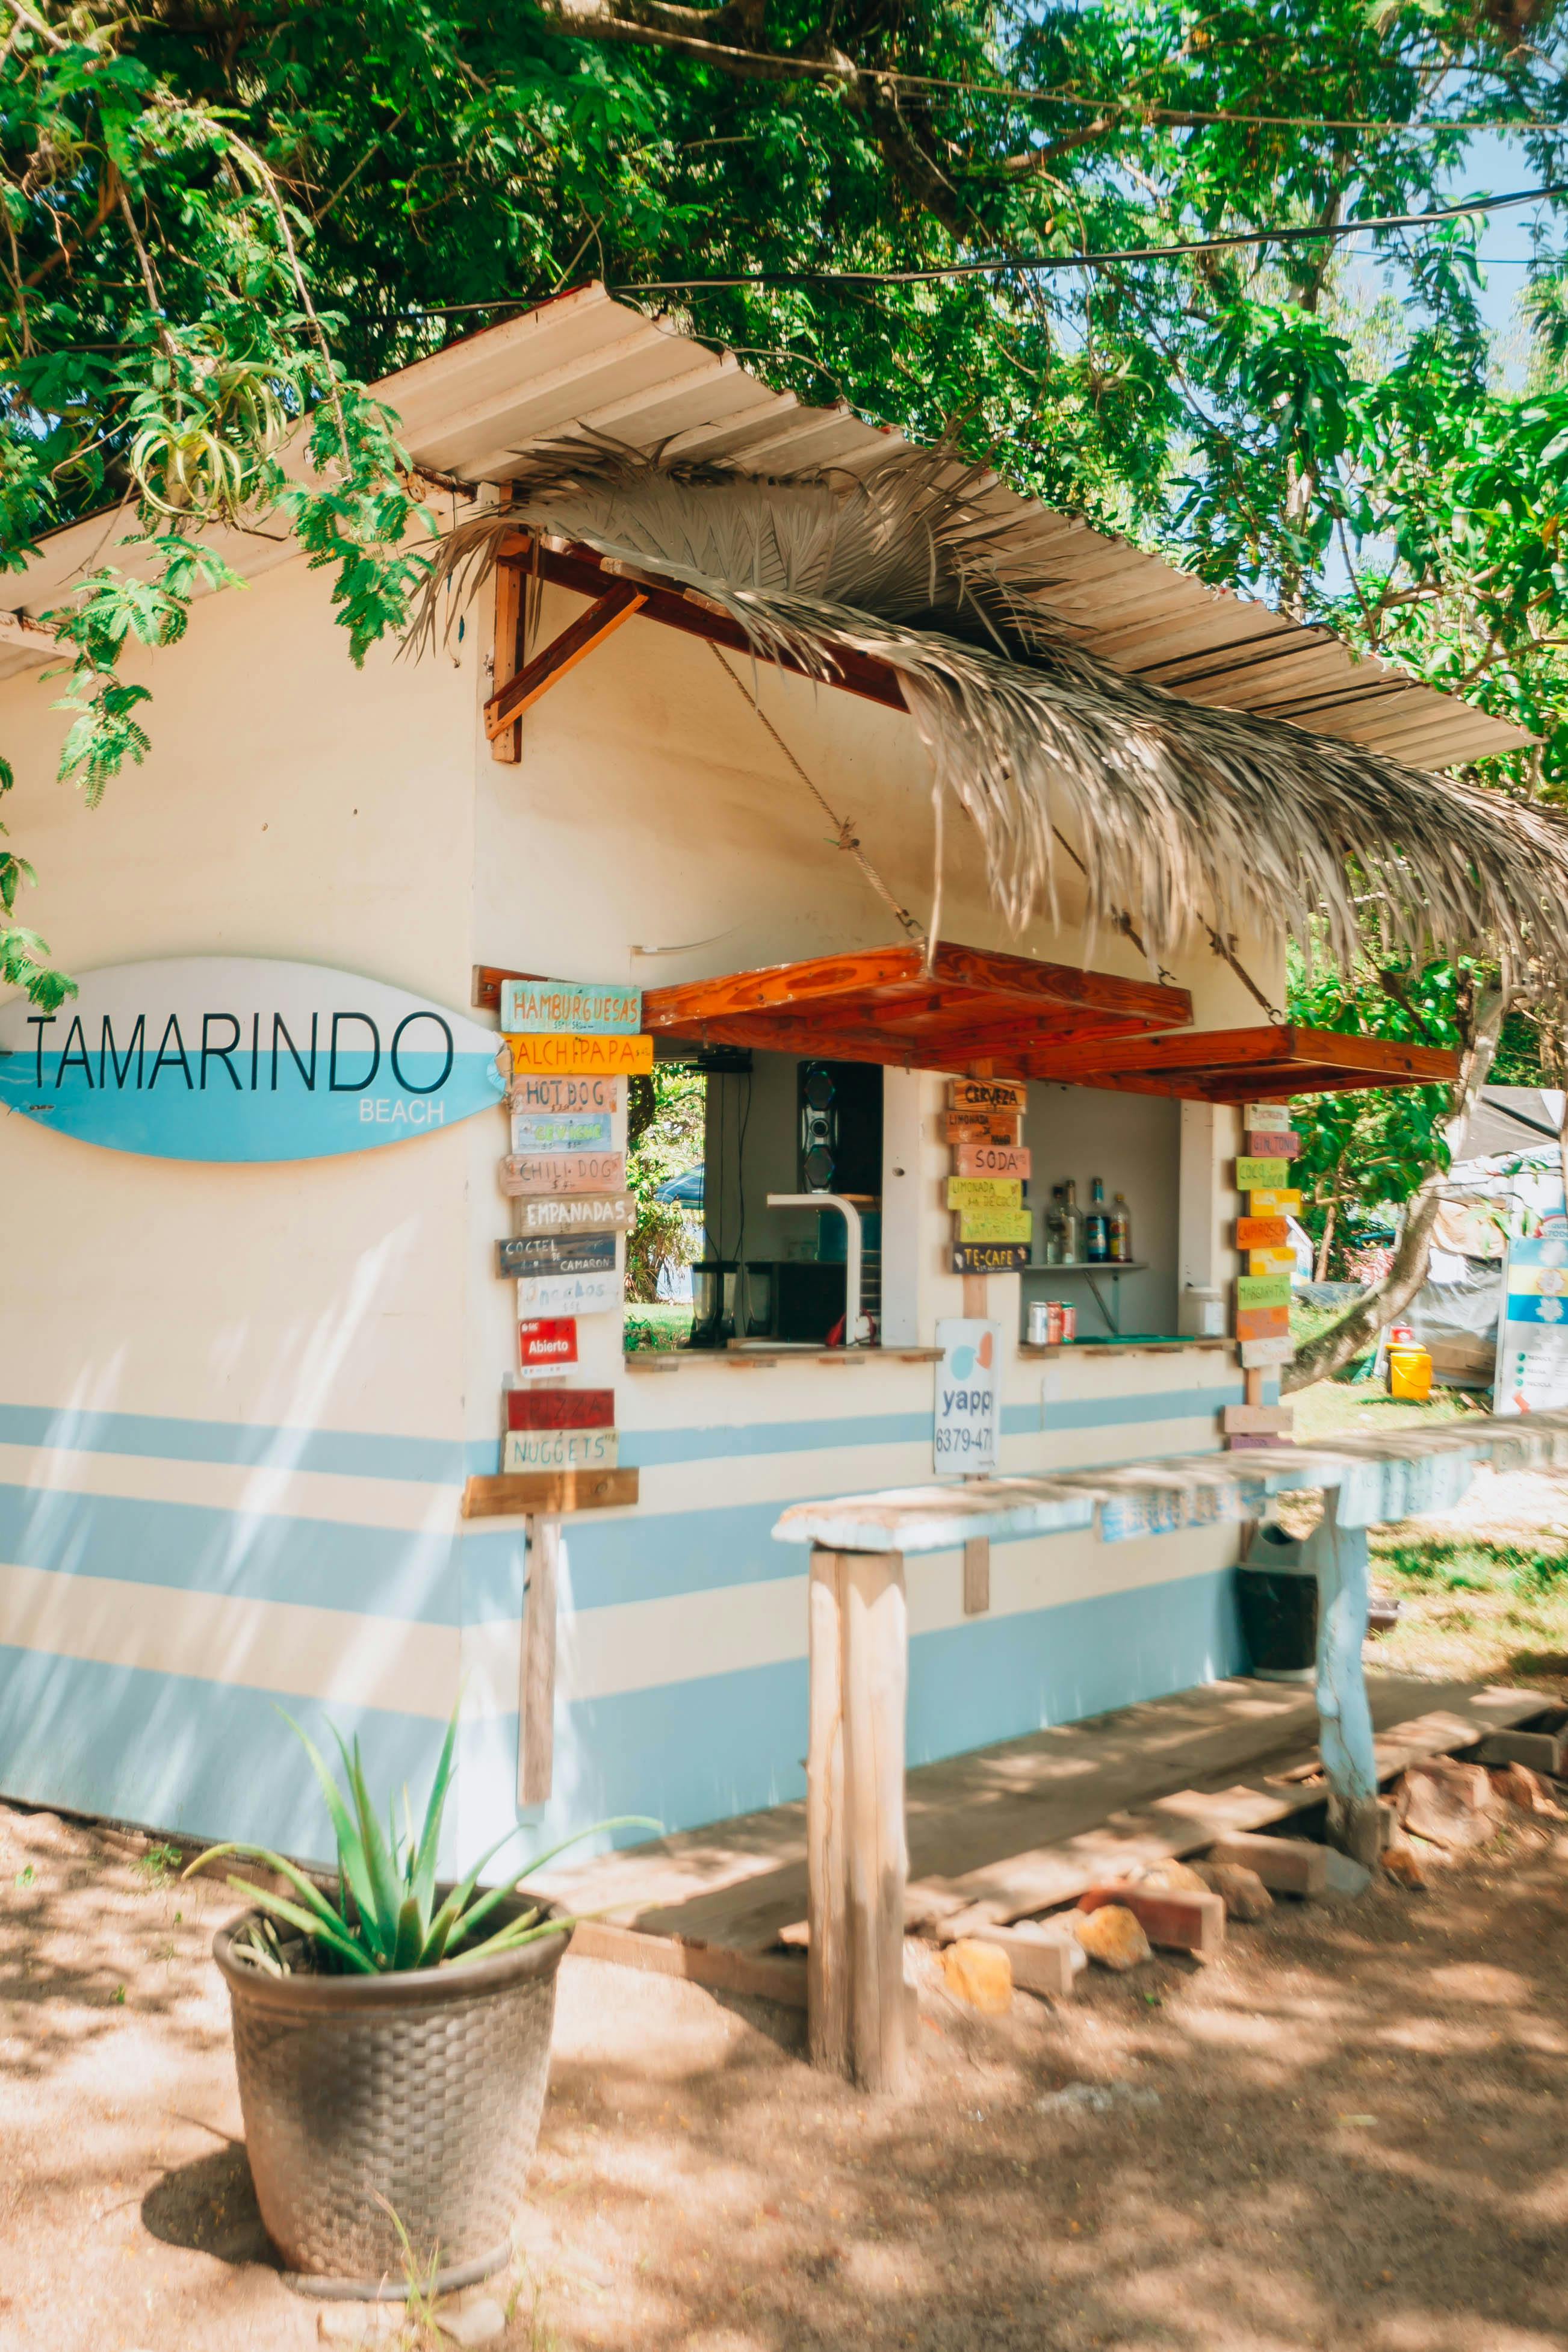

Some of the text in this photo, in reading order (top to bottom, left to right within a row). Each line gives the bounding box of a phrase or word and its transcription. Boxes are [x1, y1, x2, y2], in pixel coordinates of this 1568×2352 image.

[513, 991, 638, 1023] HAMBURGUESAS
[26, 1011, 454, 1094] TAMARINDO
[504, 1039, 634, 1066] ALCHIPAPA
[527, 1080, 604, 1106] HOT DOG
[965, 1085, 1017, 1105] CERVEZA
[360, 1099, 444, 1123] BEACH
[535, 1124, 601, 1141] CEVICHE
[520, 1159, 611, 1181] CHILI DOG
[976, 1149, 1018, 1170] SODA
[953, 1181, 994, 1194] LIMONADA
[527, 1200, 625, 1226] EMPANADAS
[506, 1239, 557, 1255] COCTEL
[551, 1252, 560, 1261] DE
[964, 1248, 1013, 1267] TE-CAFE
[560, 1258, 610, 1271] CAMARON
[528, 1339, 569, 1353] Abierto
[528, 1392, 602, 1423] PIZZA
[514, 1436, 606, 1464] NUGGETS
